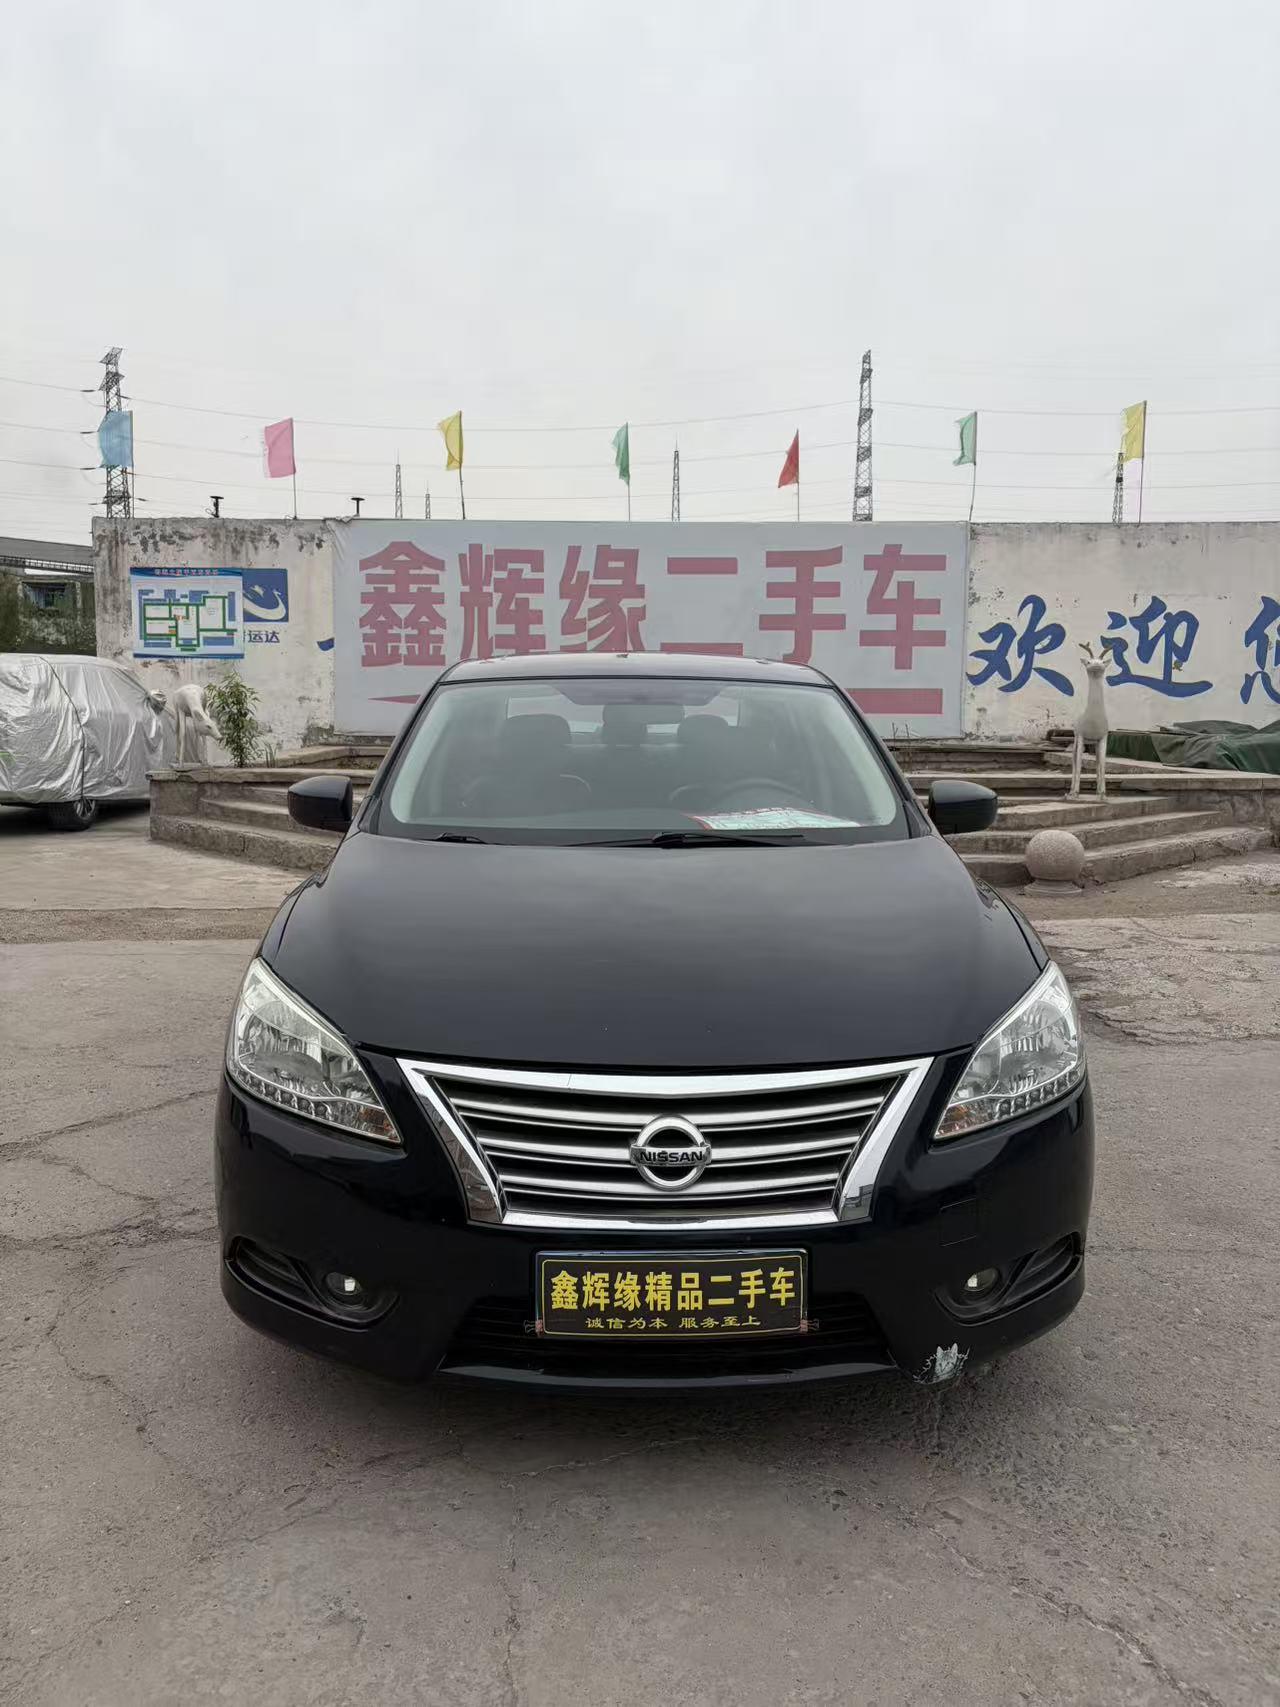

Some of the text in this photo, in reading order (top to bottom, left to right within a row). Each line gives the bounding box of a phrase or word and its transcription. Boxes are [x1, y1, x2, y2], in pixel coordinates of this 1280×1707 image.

[358, 540, 948, 671] 鑫辉缘二手车
[243, 630, 280, 643] 运达
[639, 1150, 704, 1164] NISSAN
[550, 1267, 796, 1312] 鑫辉缘精品二手车
[585, 1315, 761, 1330] 诚信为本 服务至上
